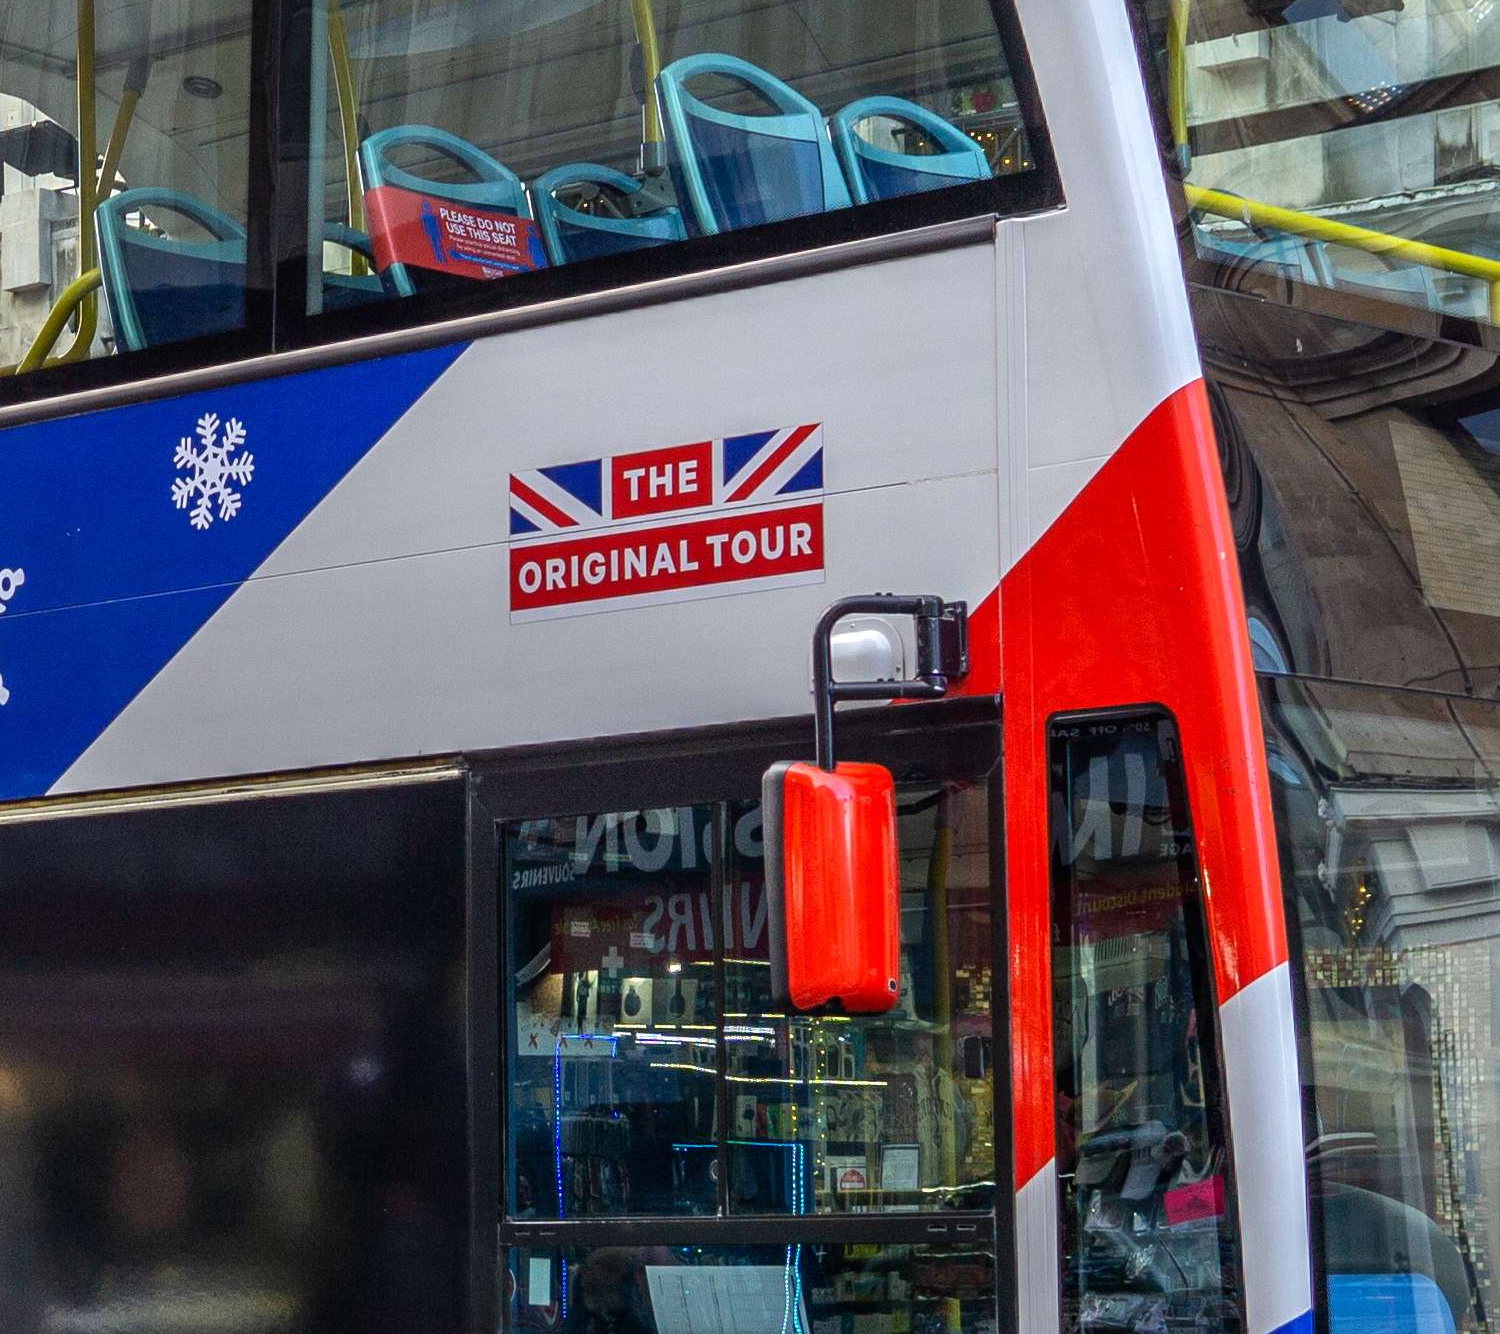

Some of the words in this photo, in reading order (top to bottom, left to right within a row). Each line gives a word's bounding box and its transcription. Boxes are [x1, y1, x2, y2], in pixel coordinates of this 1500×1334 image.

[439, 207, 476, 227] PLEASE
[477, 217, 494, 230] DO
[494, 221, 516, 234] NOT
[446, 222, 467, 237] USE
[466, 226, 491, 242] THIS
[491, 232, 517, 246] SEAT
[622, 458, 699, 502] THE
[517, 538, 700, 595] ORIGINAL
[705, 521, 813, 568] TOUR
